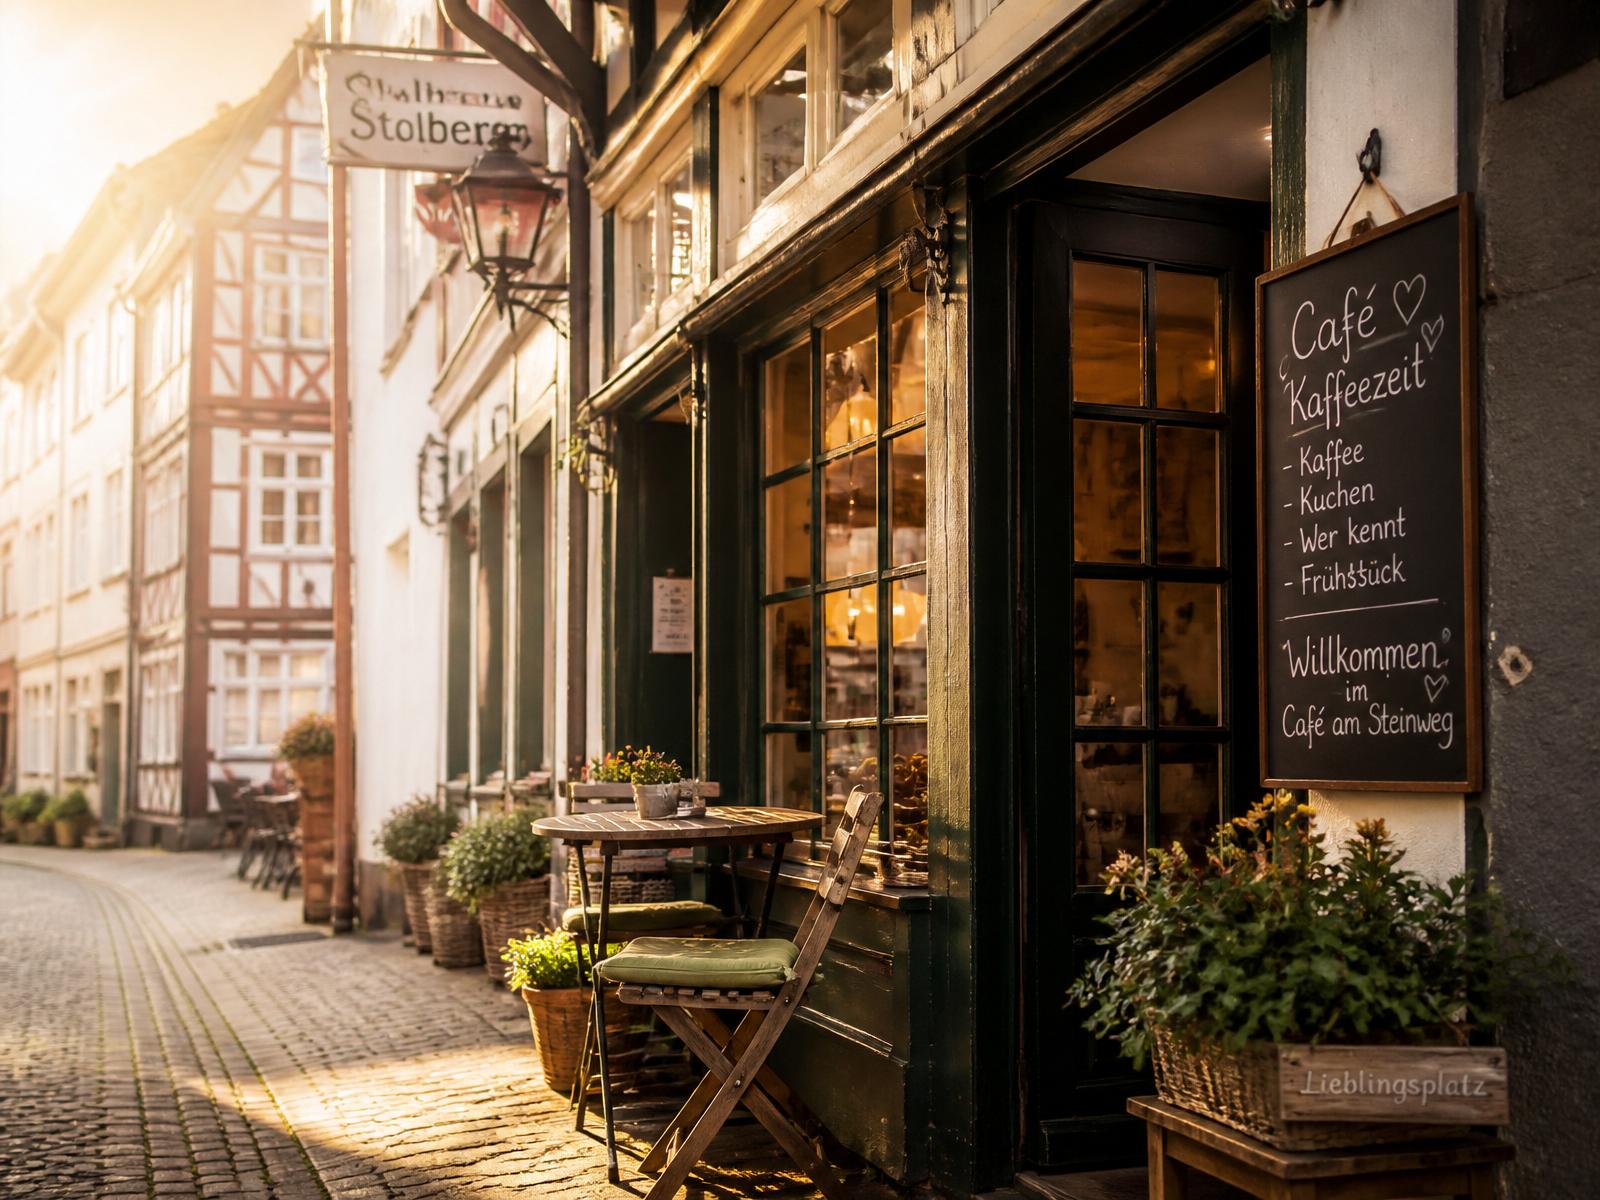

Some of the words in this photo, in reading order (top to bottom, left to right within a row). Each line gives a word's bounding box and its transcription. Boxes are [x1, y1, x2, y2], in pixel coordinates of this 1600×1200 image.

[1291, 283, 1377, 364] Café
[1286, 341, 1426, 430] Kaffeezeit
[1300, 438, 1365, 480] Kaffee
[1300, 480, 1375, 516] Kuchen
[1299, 523, 1339, 554] Wer
[1348, 506, 1407, 545] kennt
[1346, 680, 1369, 702] im
[1282, 704, 1326, 750] Café
[1332, 716, 1361, 736] am
[1368, 702, 1454, 750] Steinweg
[1300, 1070, 1488, 1106] Lieblingsplatz
